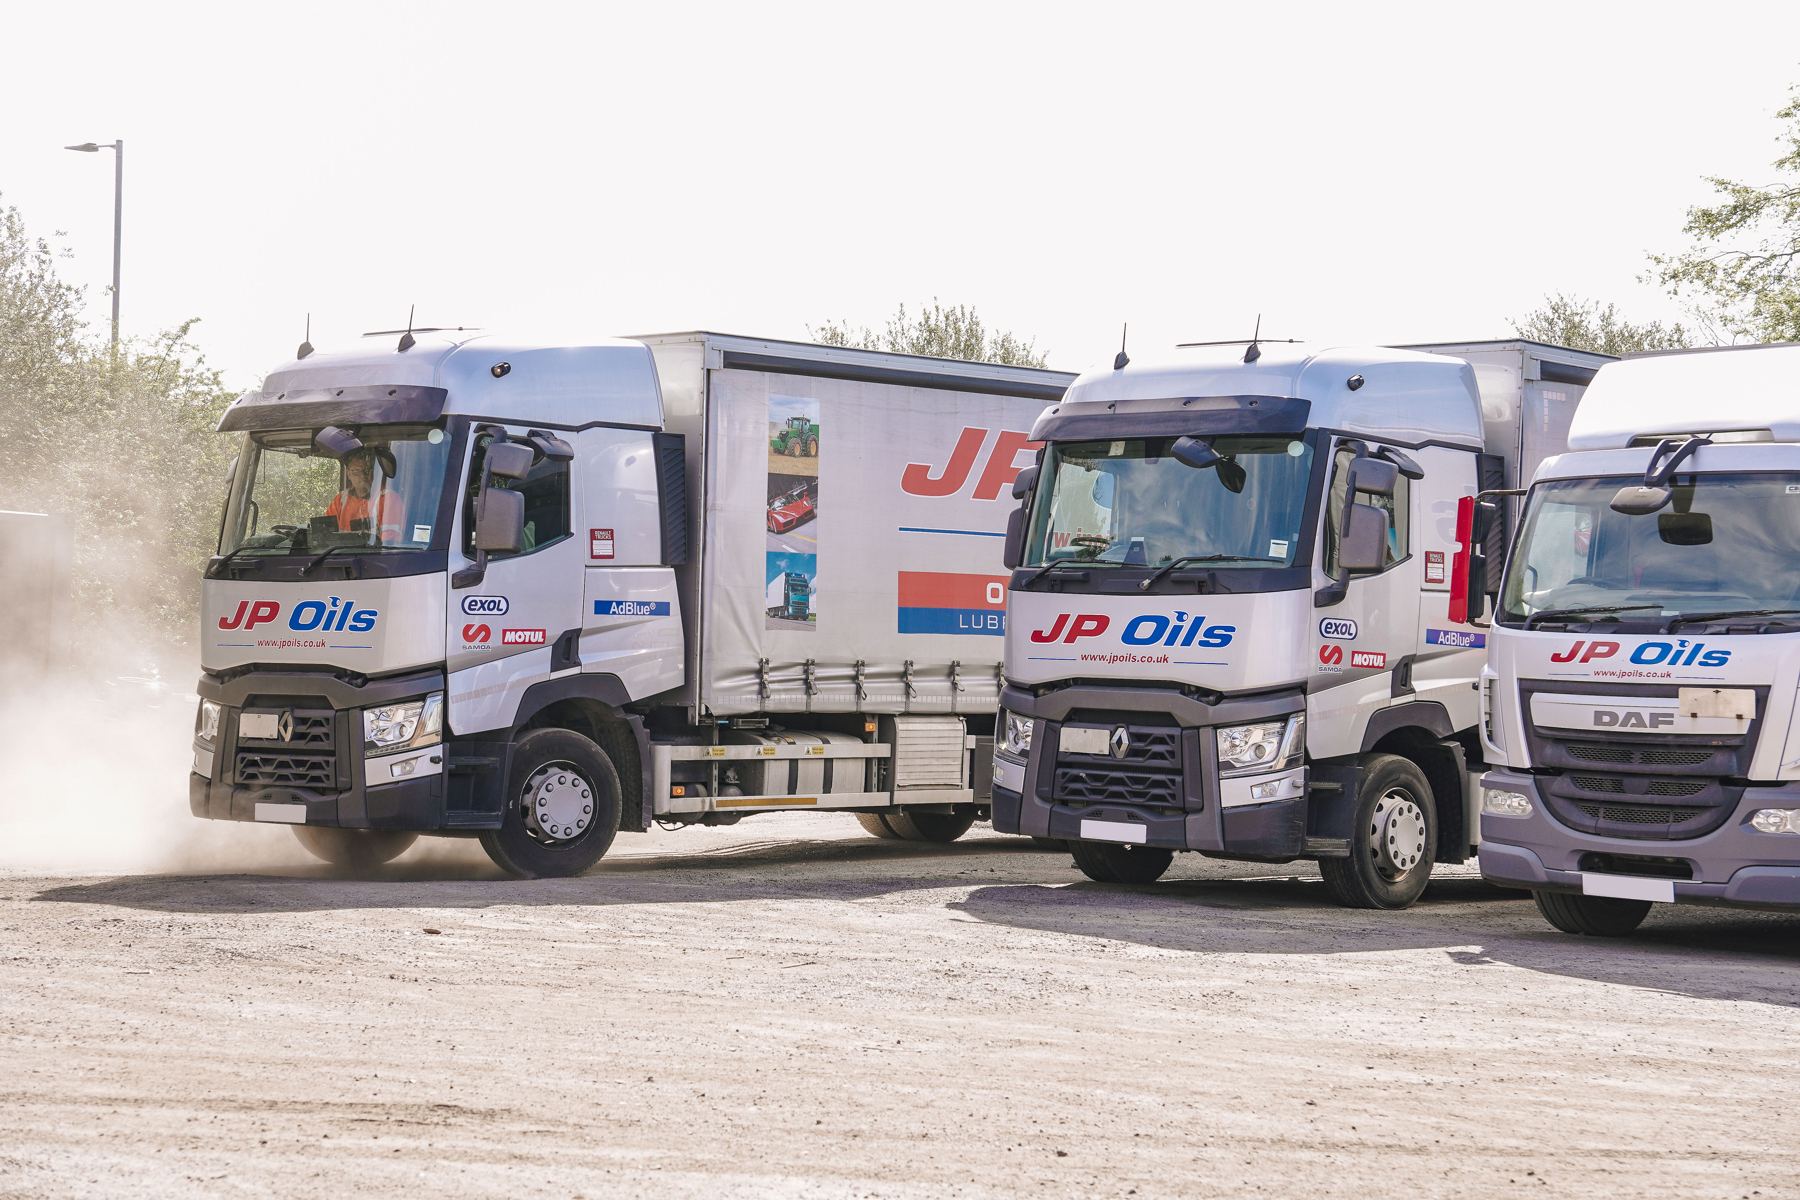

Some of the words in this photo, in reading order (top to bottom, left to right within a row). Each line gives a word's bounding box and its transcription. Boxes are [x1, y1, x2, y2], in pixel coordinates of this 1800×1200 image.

[218, 600, 281, 631] JP
[288, 596, 379, 632] Oils
[1030, 613, 1111, 644] JP
[1120, 611, 1238, 648] Oils
[257, 637, 326, 649] www.jpoils.co.uk
[504, 631, 545, 643] MOTUL
[1080, 652, 1169, 665] www.jpoils.co.uk
[1352, 653, 1385, 667] MOTUL
[1550, 640, 1620, 664] JP
[1629, 639, 1733, 667] Oils
[1593, 669, 1672, 679] www.jpoils.co.uk
[1593, 710, 1674, 729] DAF
